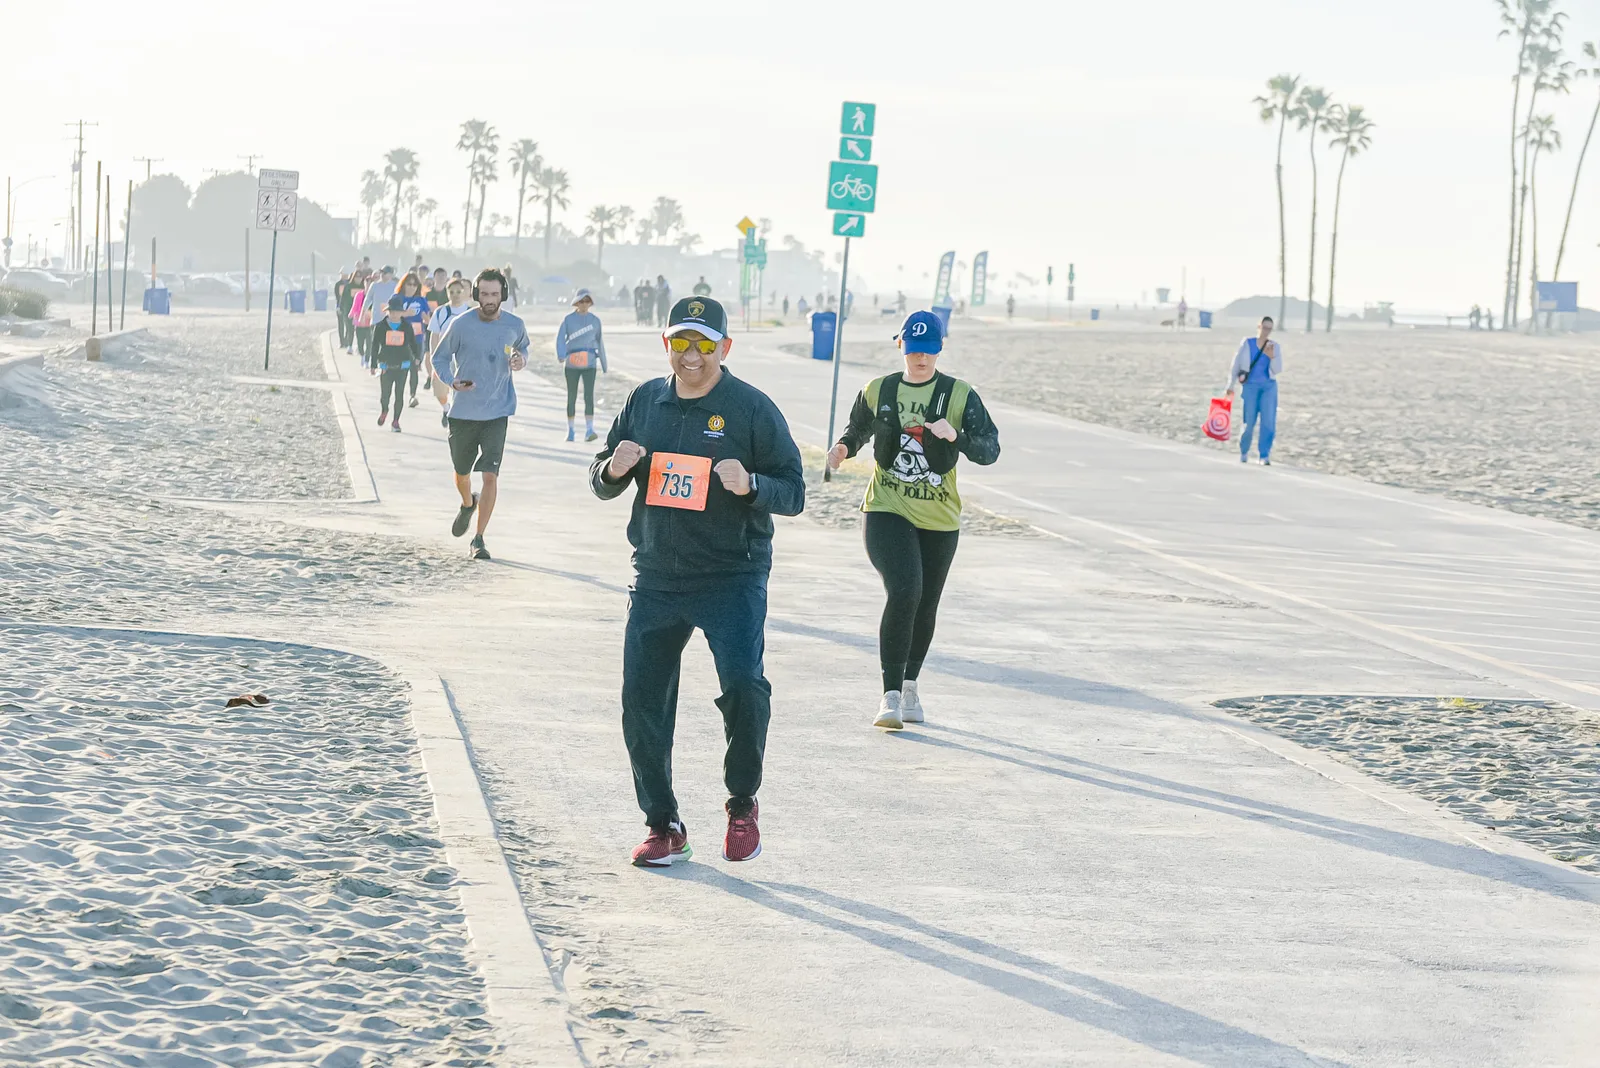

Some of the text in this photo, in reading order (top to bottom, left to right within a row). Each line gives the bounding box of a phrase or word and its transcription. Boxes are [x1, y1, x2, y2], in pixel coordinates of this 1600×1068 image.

[912, 321, 928, 337] D
[910, 401, 930, 417] IN
[660, 472, 693, 499] 735
